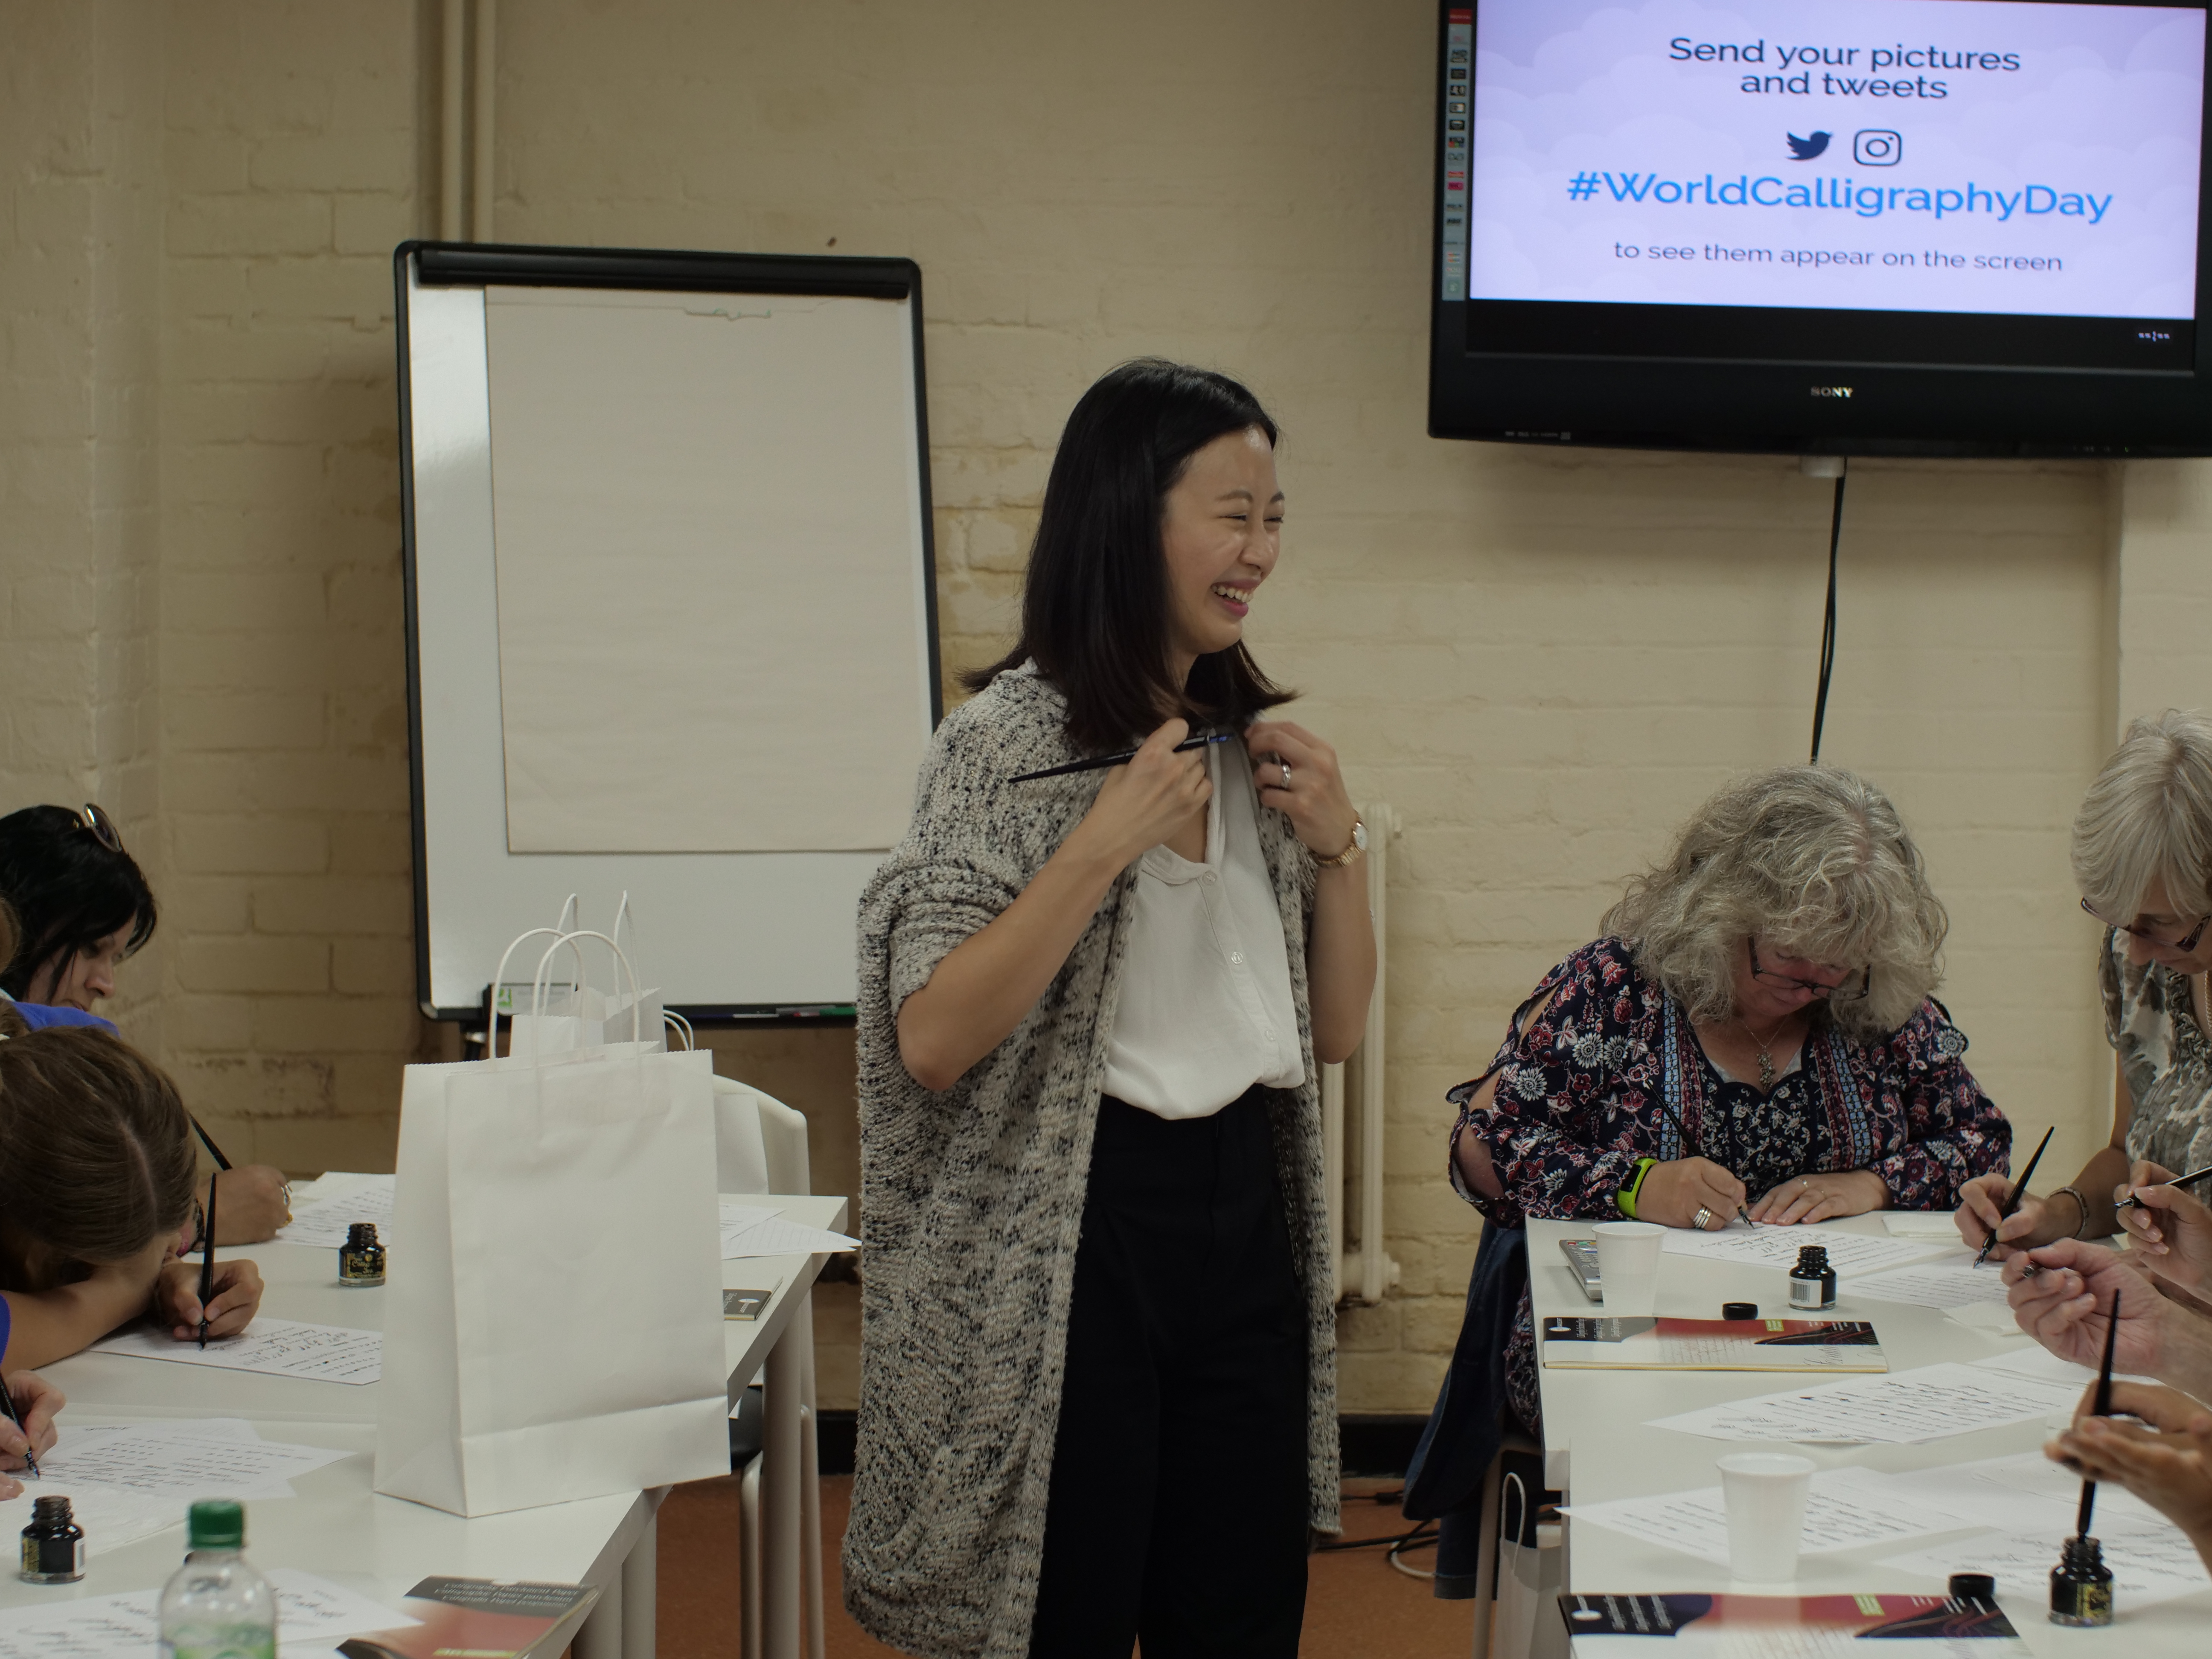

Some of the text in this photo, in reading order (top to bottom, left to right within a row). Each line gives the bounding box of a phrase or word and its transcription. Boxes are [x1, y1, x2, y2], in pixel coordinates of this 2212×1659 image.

[1669, 36, 2021, 73] Send your pictures
[1740, 70, 1948, 99] and tweets
[1567, 171, 2113, 224] #WorldCalligraphyDay
[1615, 242, 2063, 271] to see them appear on the screen
[1810, 386, 1853, 398] SONY
